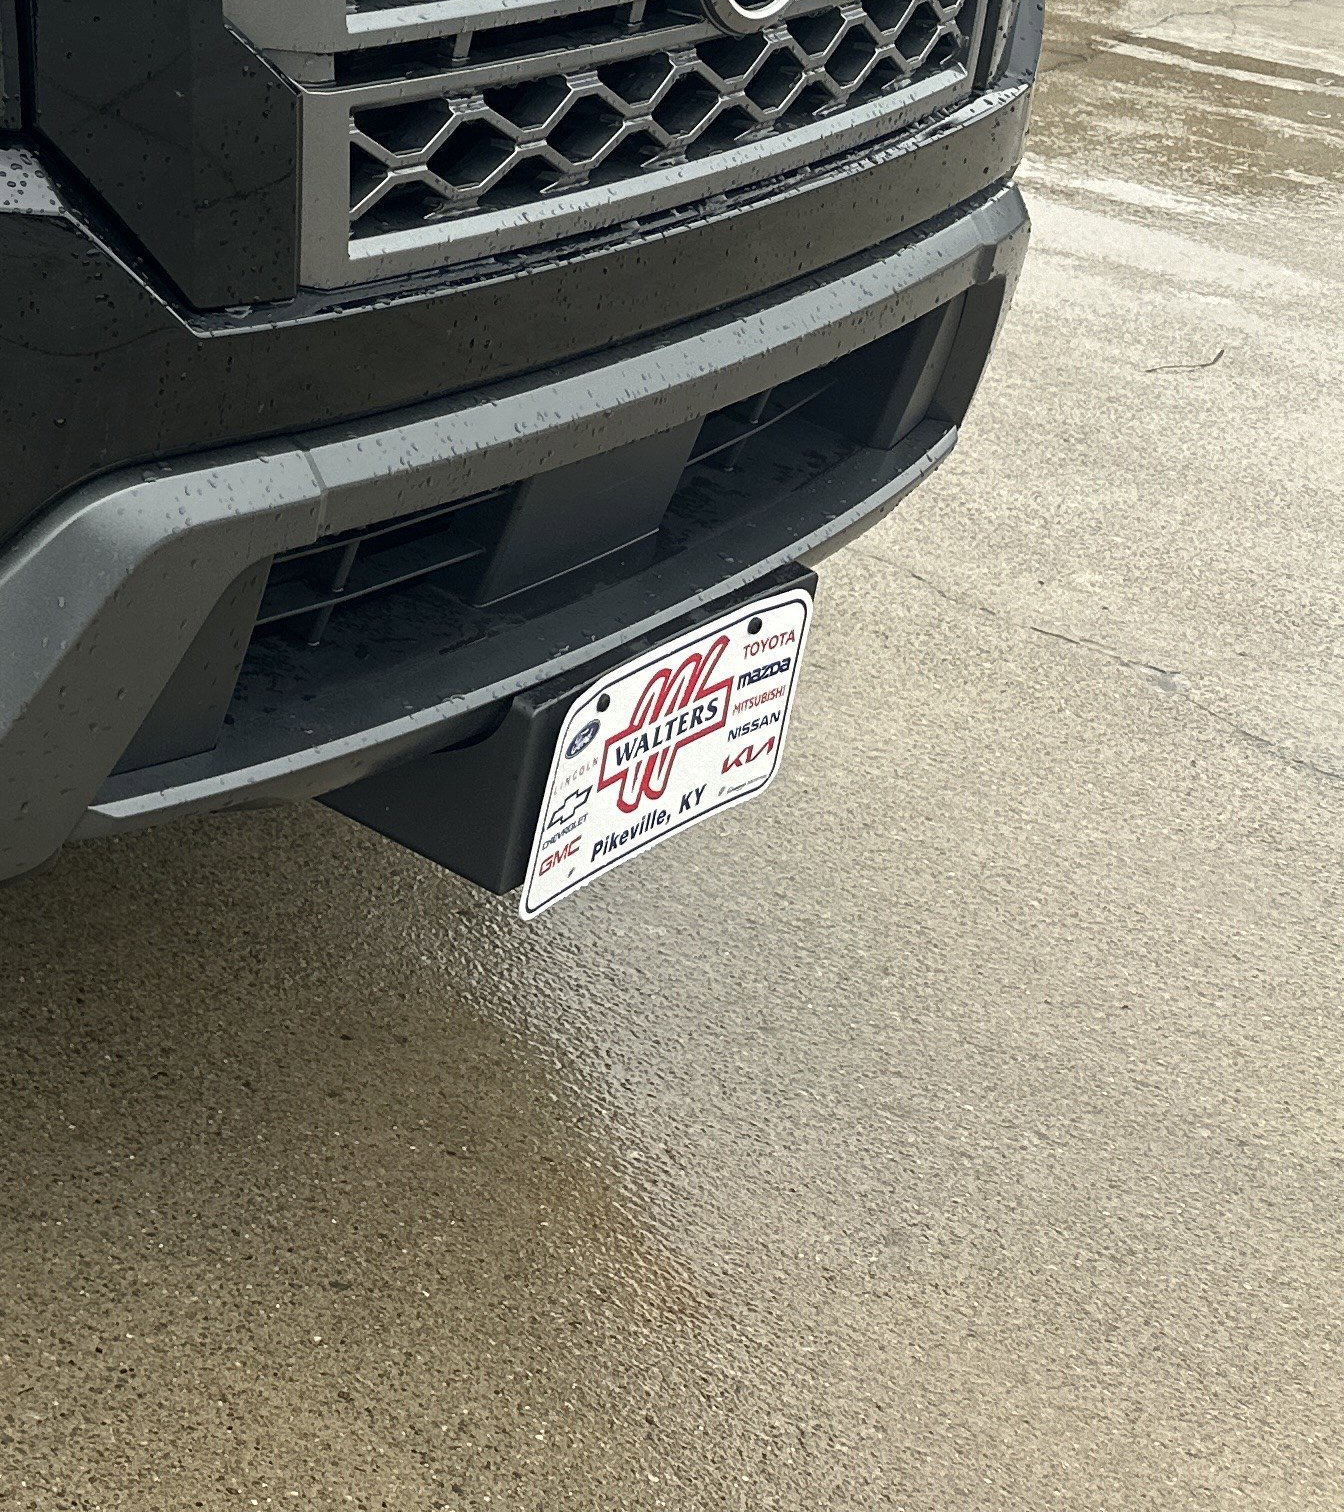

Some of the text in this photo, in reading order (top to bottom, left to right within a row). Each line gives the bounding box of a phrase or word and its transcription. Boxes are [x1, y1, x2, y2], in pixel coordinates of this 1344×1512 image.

[743, 629, 796, 660] TOYOTA
[732, 685, 787, 716] MITSUBISHI
[615, 696, 719, 766] WALTERS
[727, 710, 781, 742] NISSAN
[553, 756, 599, 796] LINCOLN
[542, 812, 589, 851] CHEVROLET
[590, 806, 672, 863] Pikeville,
[678, 783, 708, 813] KY
[538, 834, 583, 877] GMC
